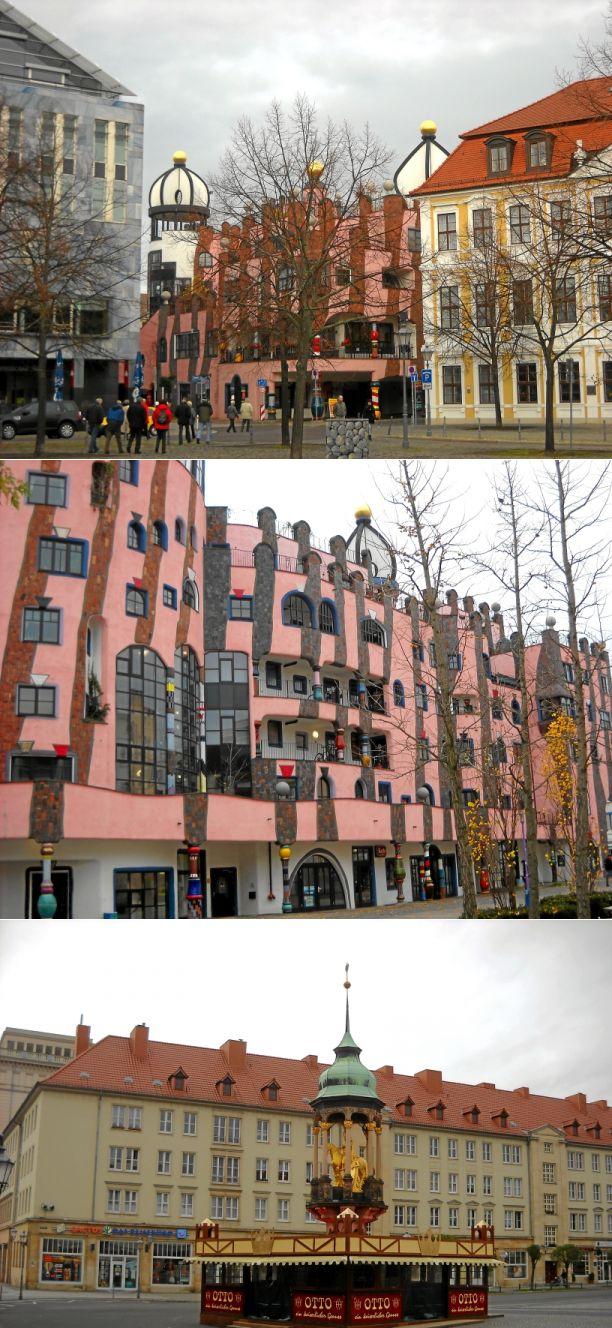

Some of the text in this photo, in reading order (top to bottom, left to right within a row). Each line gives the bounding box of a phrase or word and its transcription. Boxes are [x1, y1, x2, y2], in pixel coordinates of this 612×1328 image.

[212, 1291, 234, 1302] OTTO
[458, 1293, 479, 1305] OTTO
[304, 1296, 332, 1310] OTTO
[364, 1297, 391, 1310] OTTO
